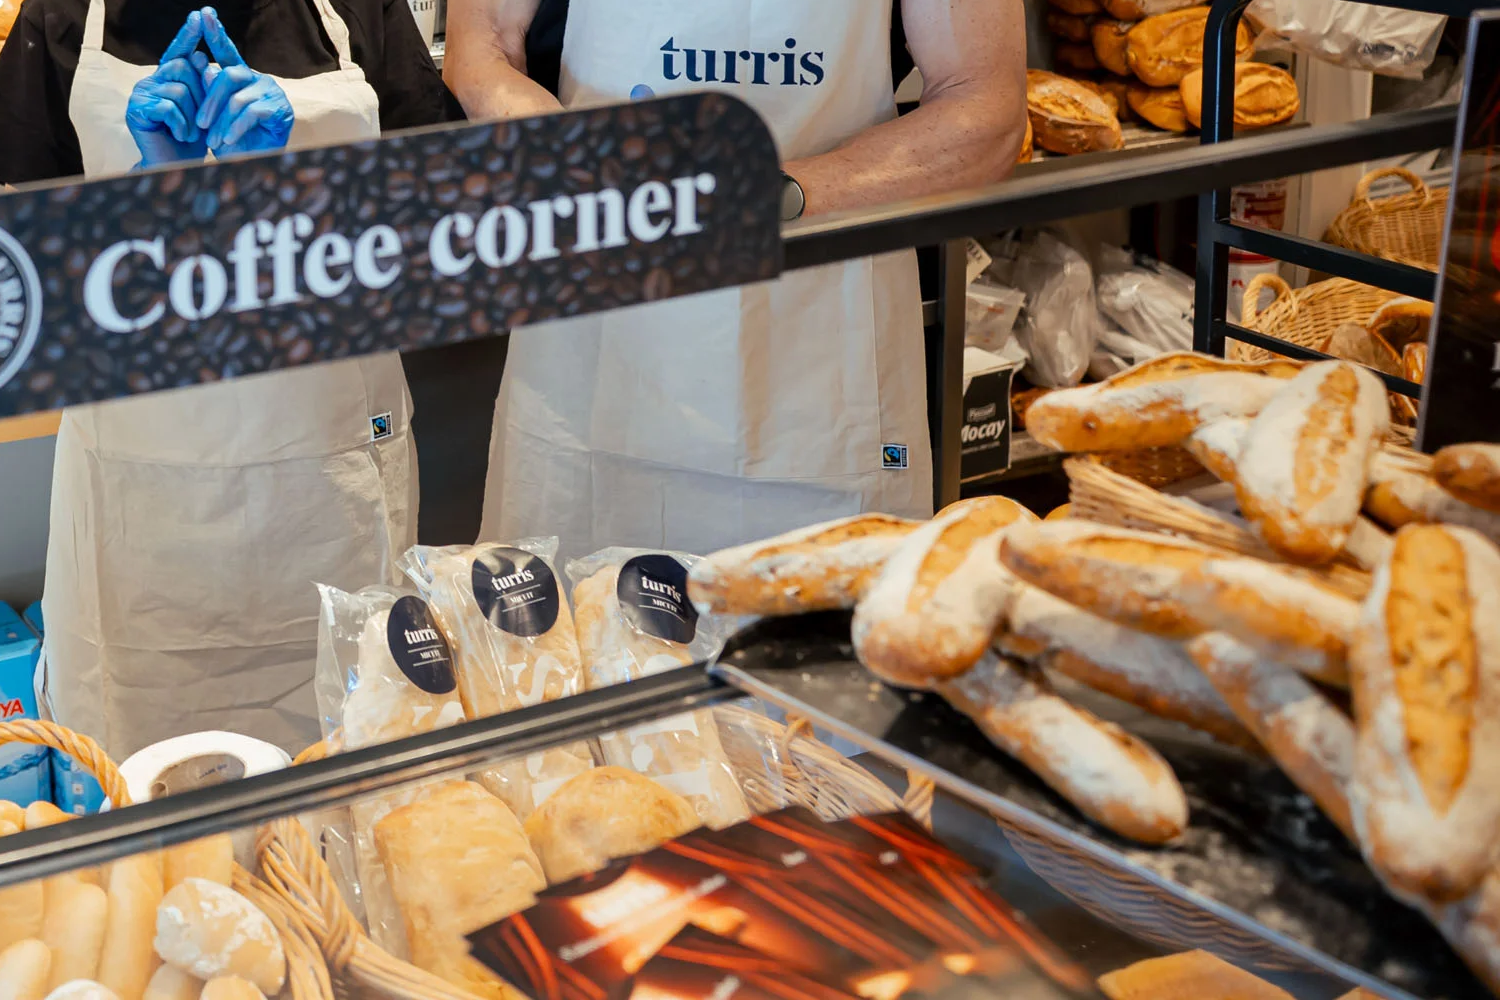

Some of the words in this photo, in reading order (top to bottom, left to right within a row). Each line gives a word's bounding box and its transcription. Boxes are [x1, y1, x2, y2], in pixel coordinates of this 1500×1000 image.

[659, 36, 825, 86] turris
[83, 213, 400, 334] Coffee
[428, 172, 716, 277] corner
[491, 568, 534, 591] turris
[641, 575, 682, 603] turris
[404, 624, 437, 645] turris
